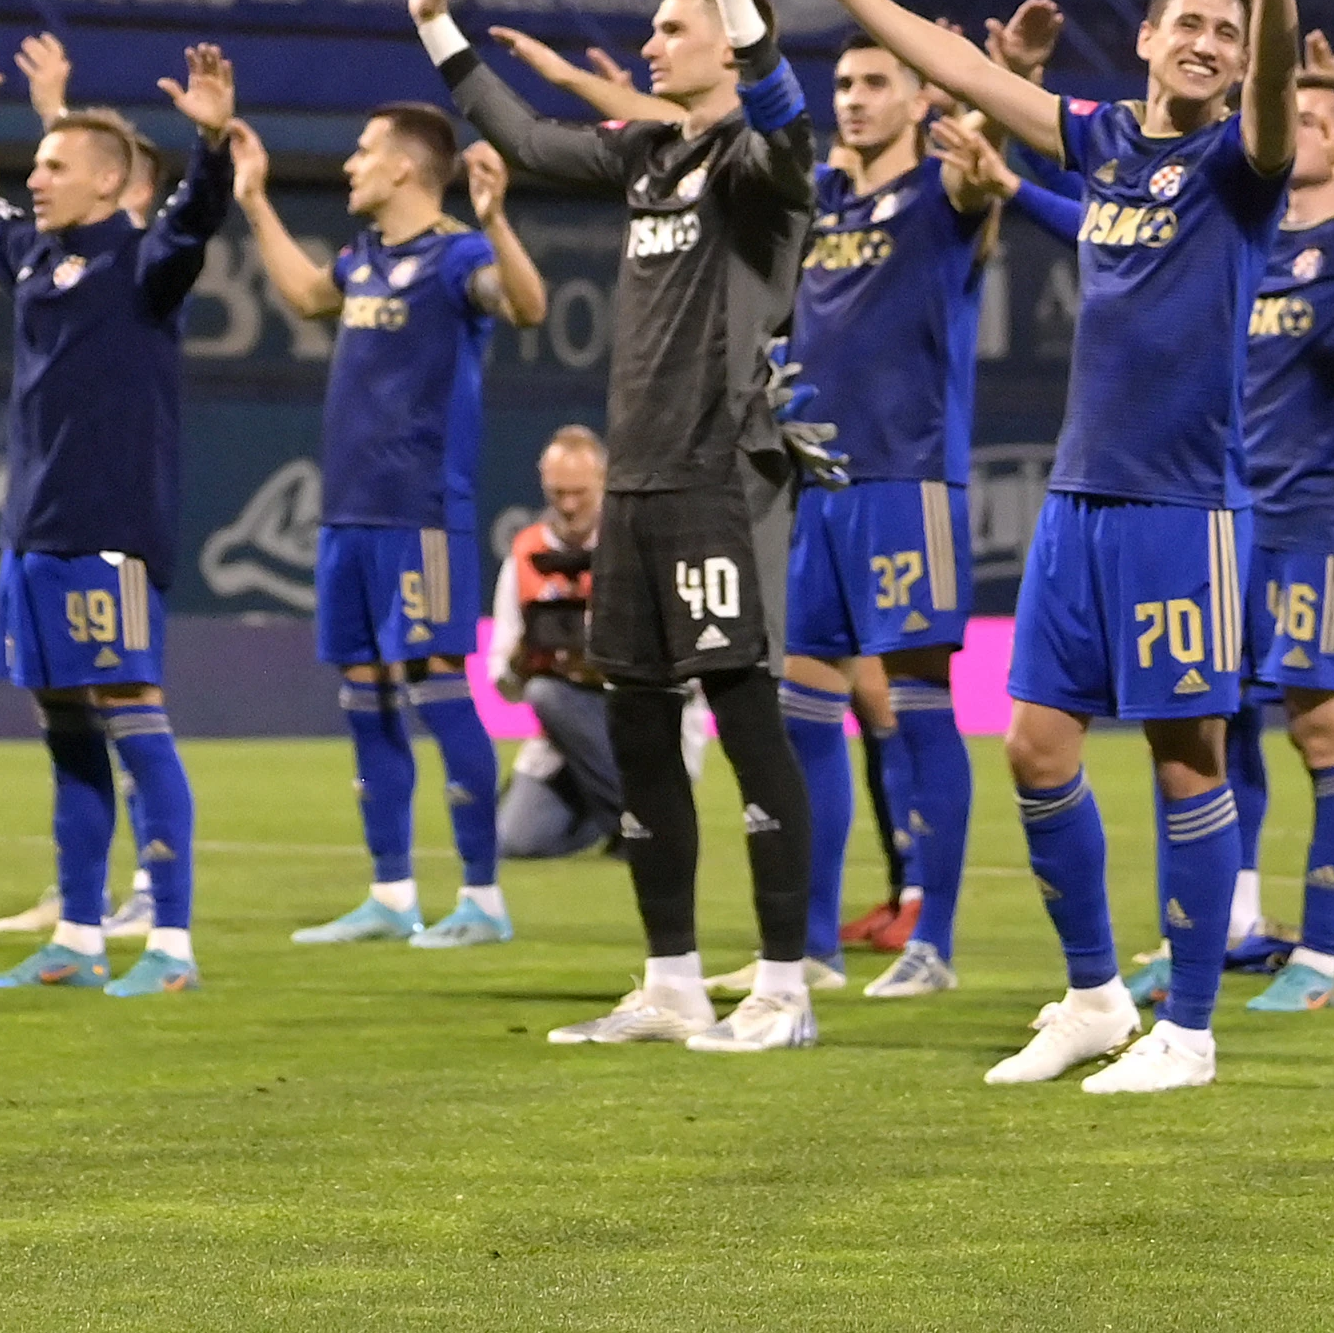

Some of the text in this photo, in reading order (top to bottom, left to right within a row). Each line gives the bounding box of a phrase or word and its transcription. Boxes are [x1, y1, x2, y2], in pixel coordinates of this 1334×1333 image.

[675, 556, 741, 621] 40
[870, 550, 923, 610] 37
[65, 589, 118, 643] 99
[1134, 597, 1205, 669] 70
